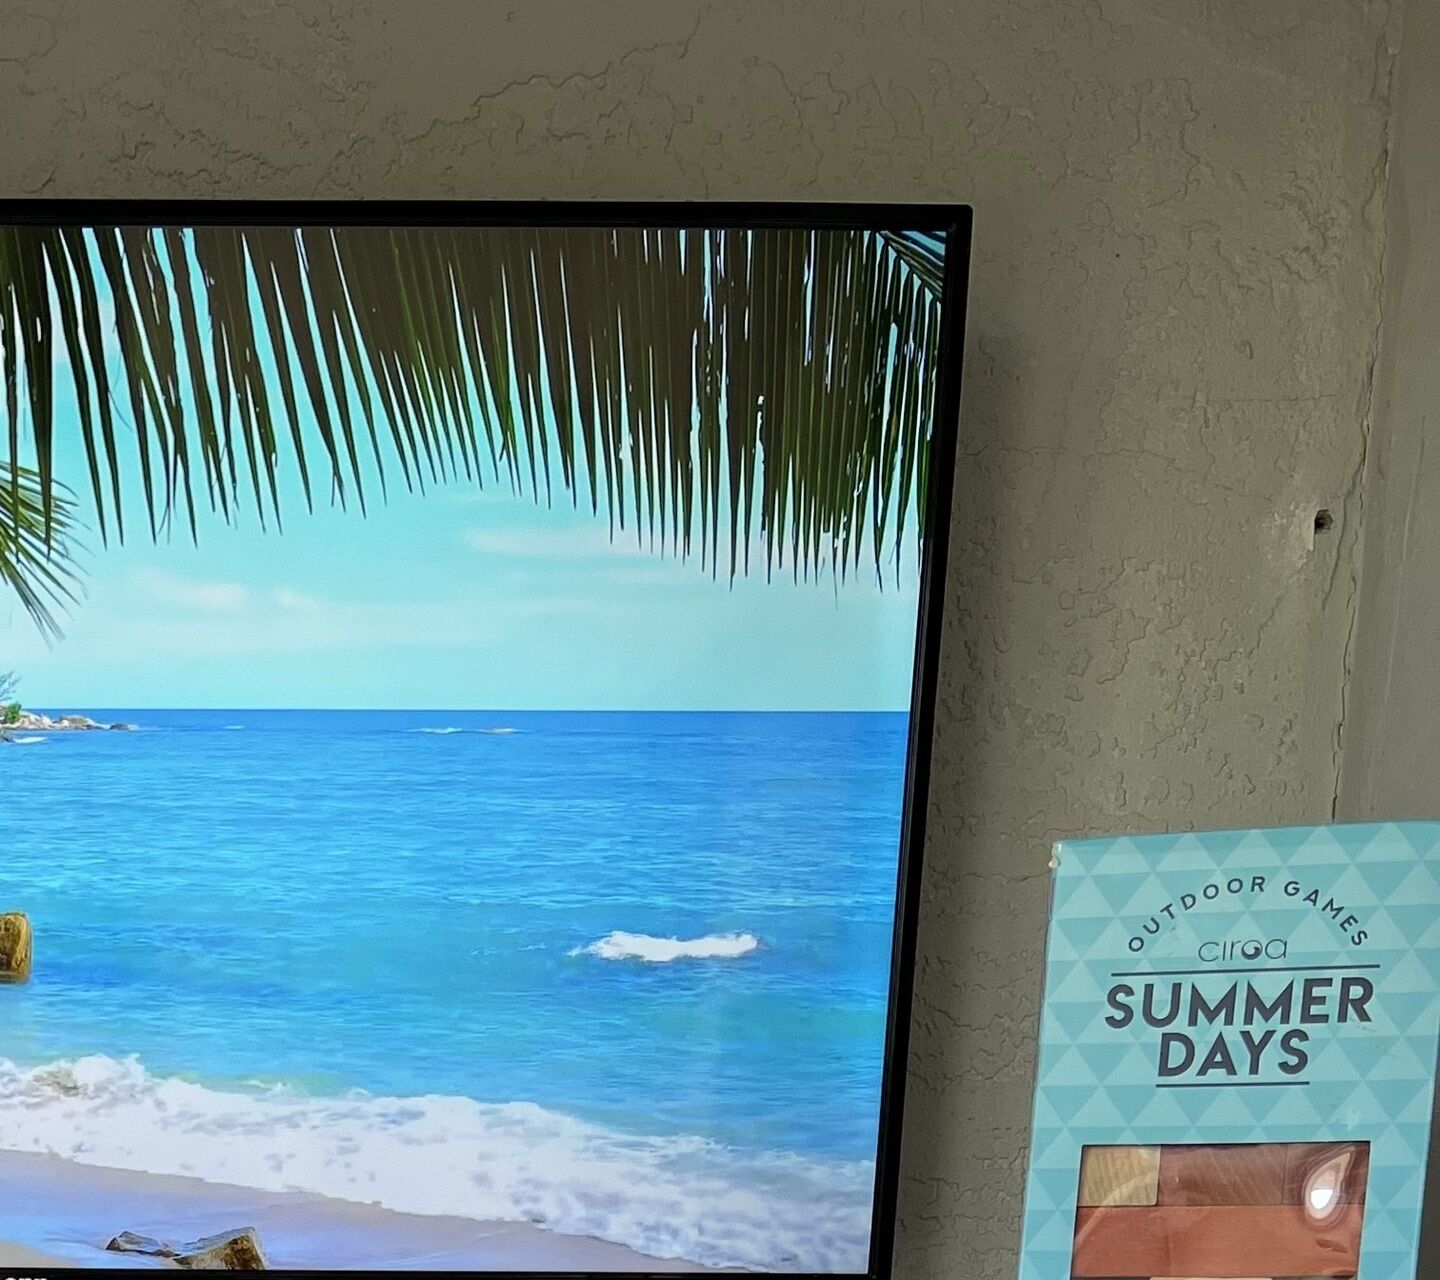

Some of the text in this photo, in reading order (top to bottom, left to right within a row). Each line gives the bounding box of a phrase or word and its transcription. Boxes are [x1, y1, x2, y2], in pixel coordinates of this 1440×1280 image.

[1127, 875, 1368, 953] OUTDOOR GAMES
[1105, 977, 1374, 1029] SUMMER
[1158, 1029, 1310, 1078] DAYS
